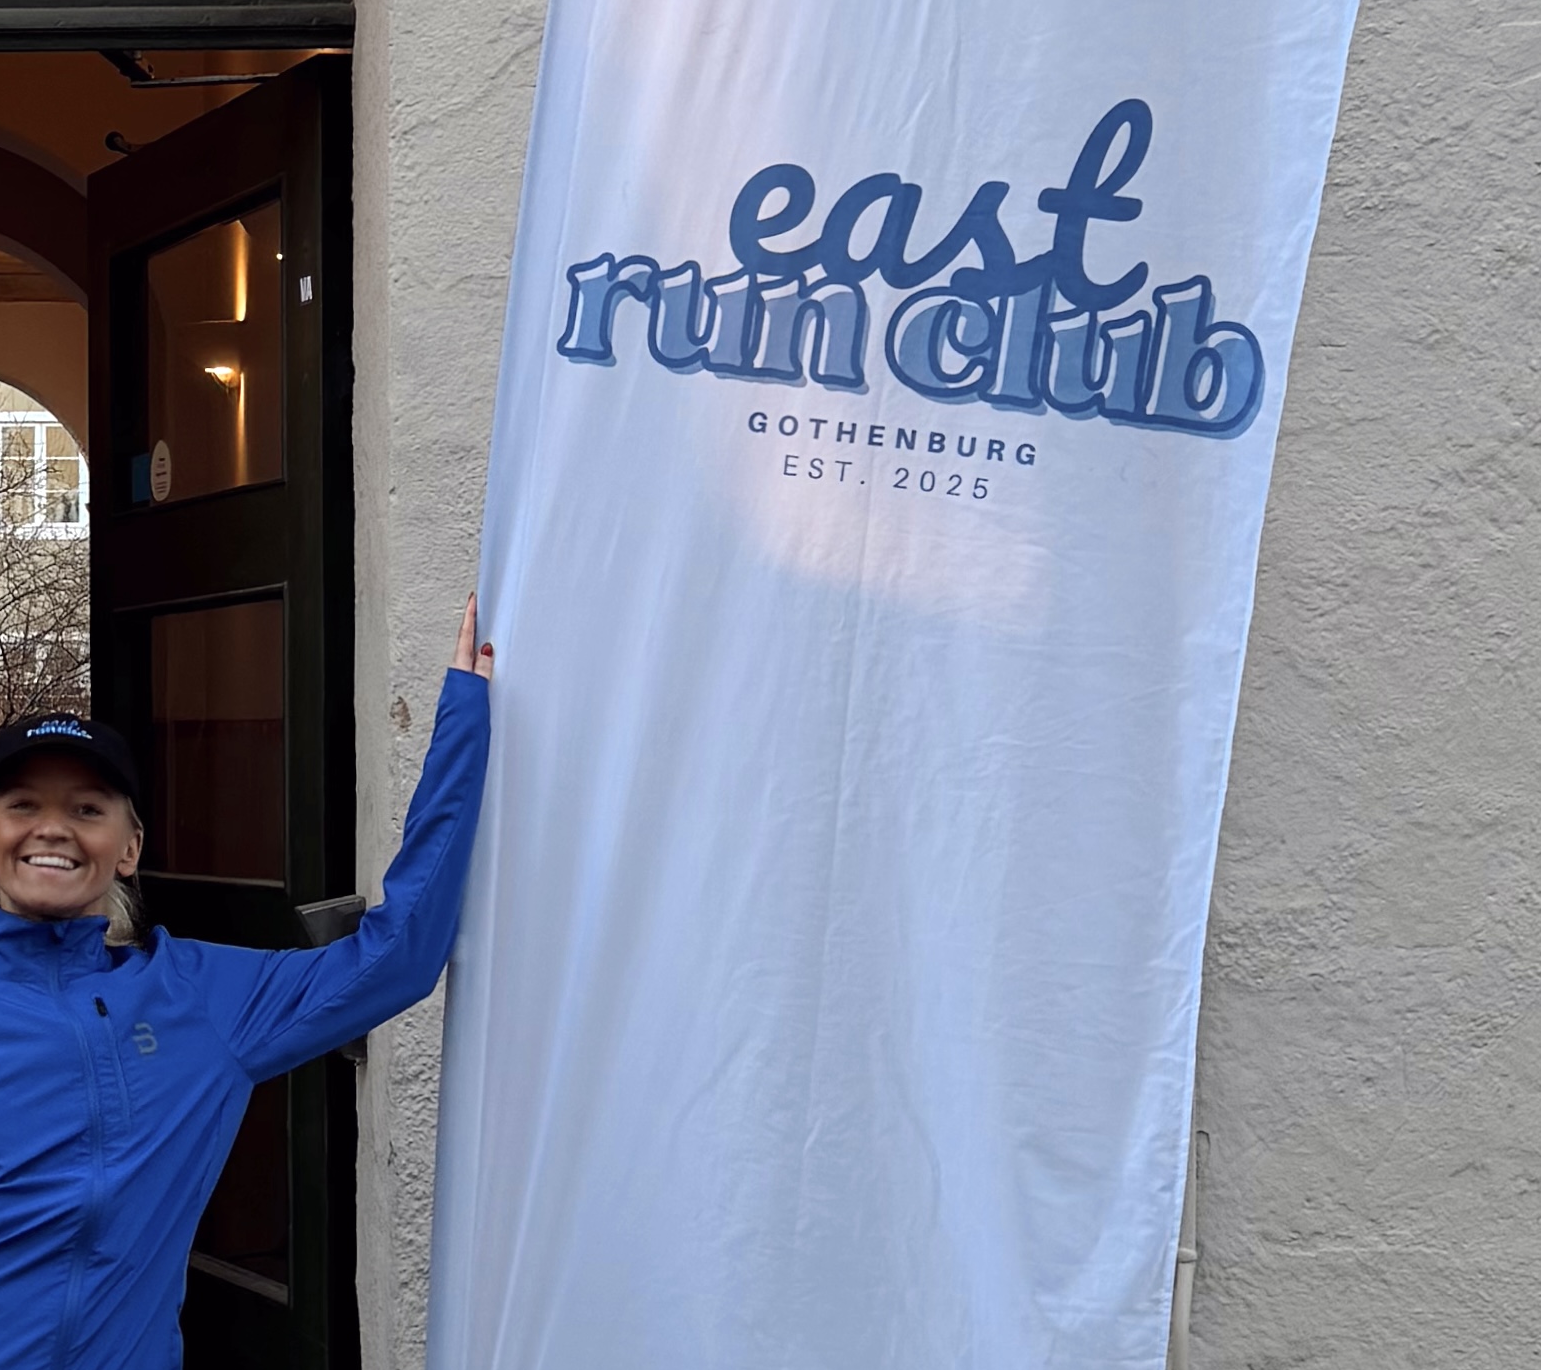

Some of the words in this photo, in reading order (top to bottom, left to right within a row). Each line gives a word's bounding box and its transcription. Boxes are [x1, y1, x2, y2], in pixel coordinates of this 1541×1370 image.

[729, 98, 1153, 311] east
[557, 252, 869, 395] run
[885, 273, 1266, 440] club
[748, 411, 1037, 466] GOTHENBURG
[782, 454, 866, 485] EST.
[893, 467, 990, 499] 2025
